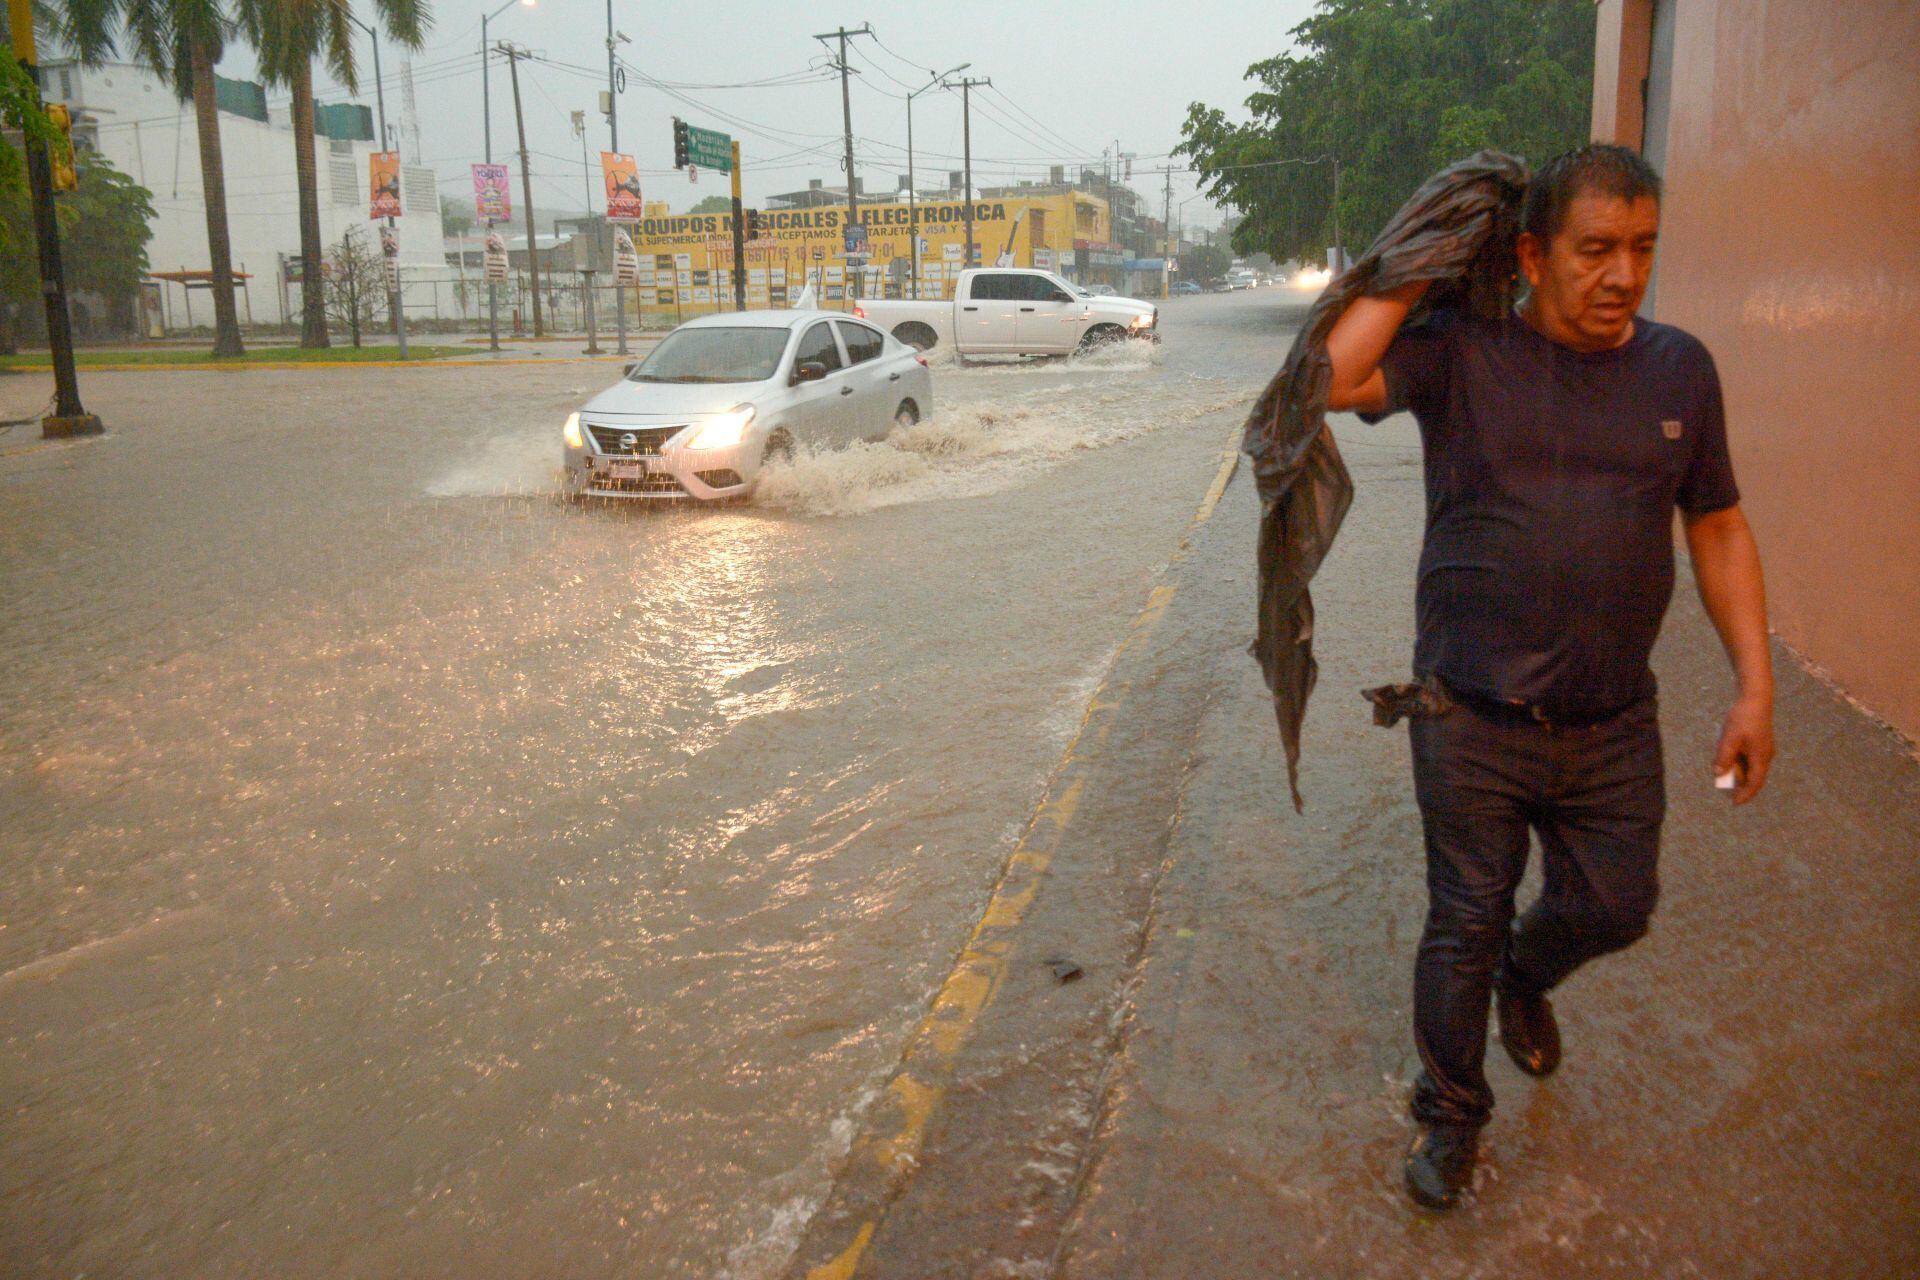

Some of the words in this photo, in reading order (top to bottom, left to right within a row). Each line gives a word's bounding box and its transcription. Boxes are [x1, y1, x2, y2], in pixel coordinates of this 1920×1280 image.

[634, 216, 717, 235] EQUIPOS
[723, 211, 838, 232] MSICALES
[862, 204, 1006, 226] ELECTRONICA
[778, 230, 837, 240] ACEPTAMOS
[868, 226, 919, 237] TARJETAS
[925, 225, 947, 234] VISA
